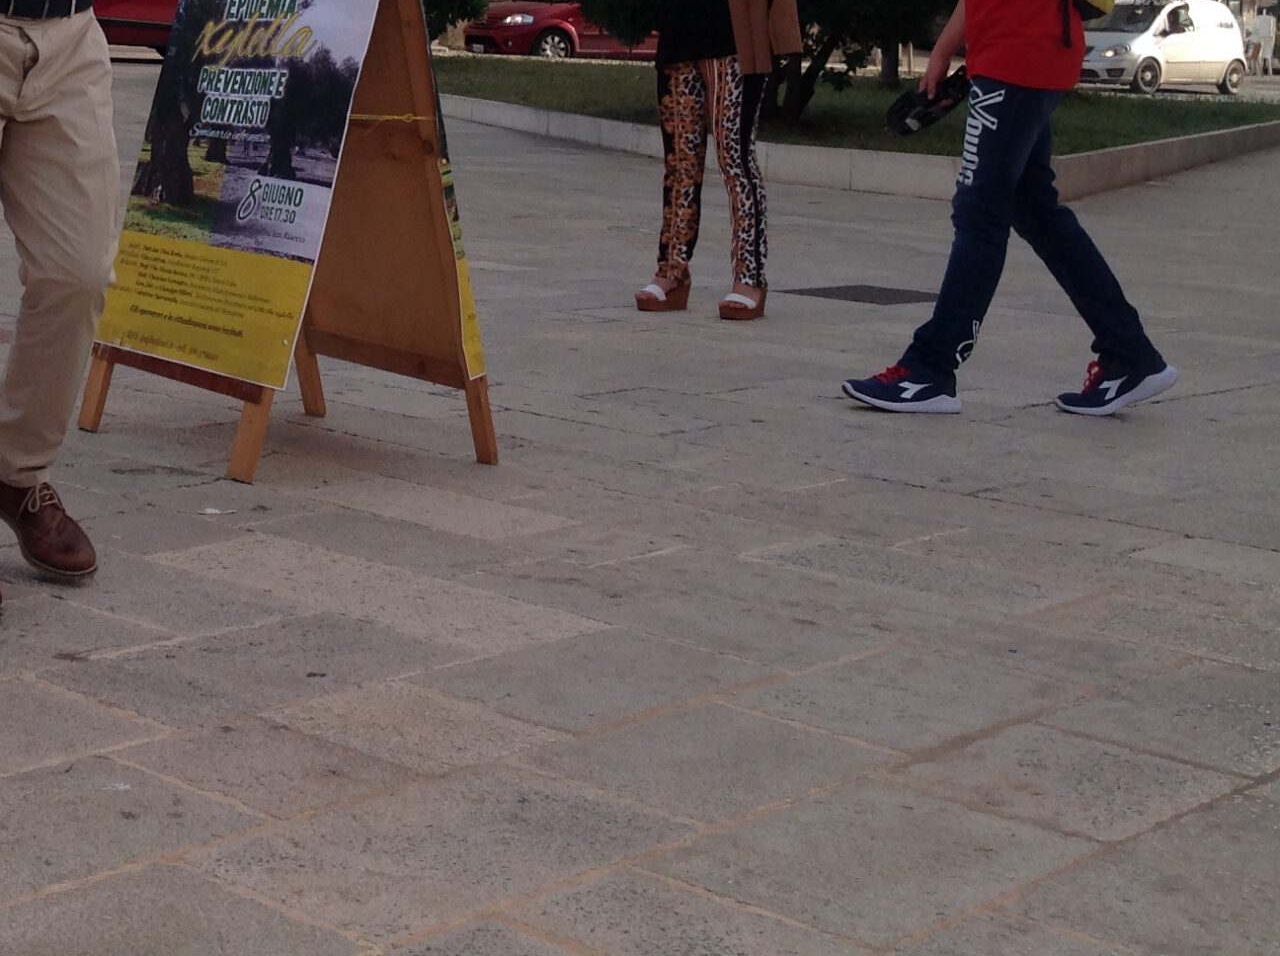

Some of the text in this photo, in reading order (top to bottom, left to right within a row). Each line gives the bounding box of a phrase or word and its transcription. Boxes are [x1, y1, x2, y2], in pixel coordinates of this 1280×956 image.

[199, 68, 287, 96] PREVENZIONE E
[202, 98, 269, 125] CONTRASTO
[237, 178, 263, 220] 8
[261, 183, 304, 207] GIUGNO
